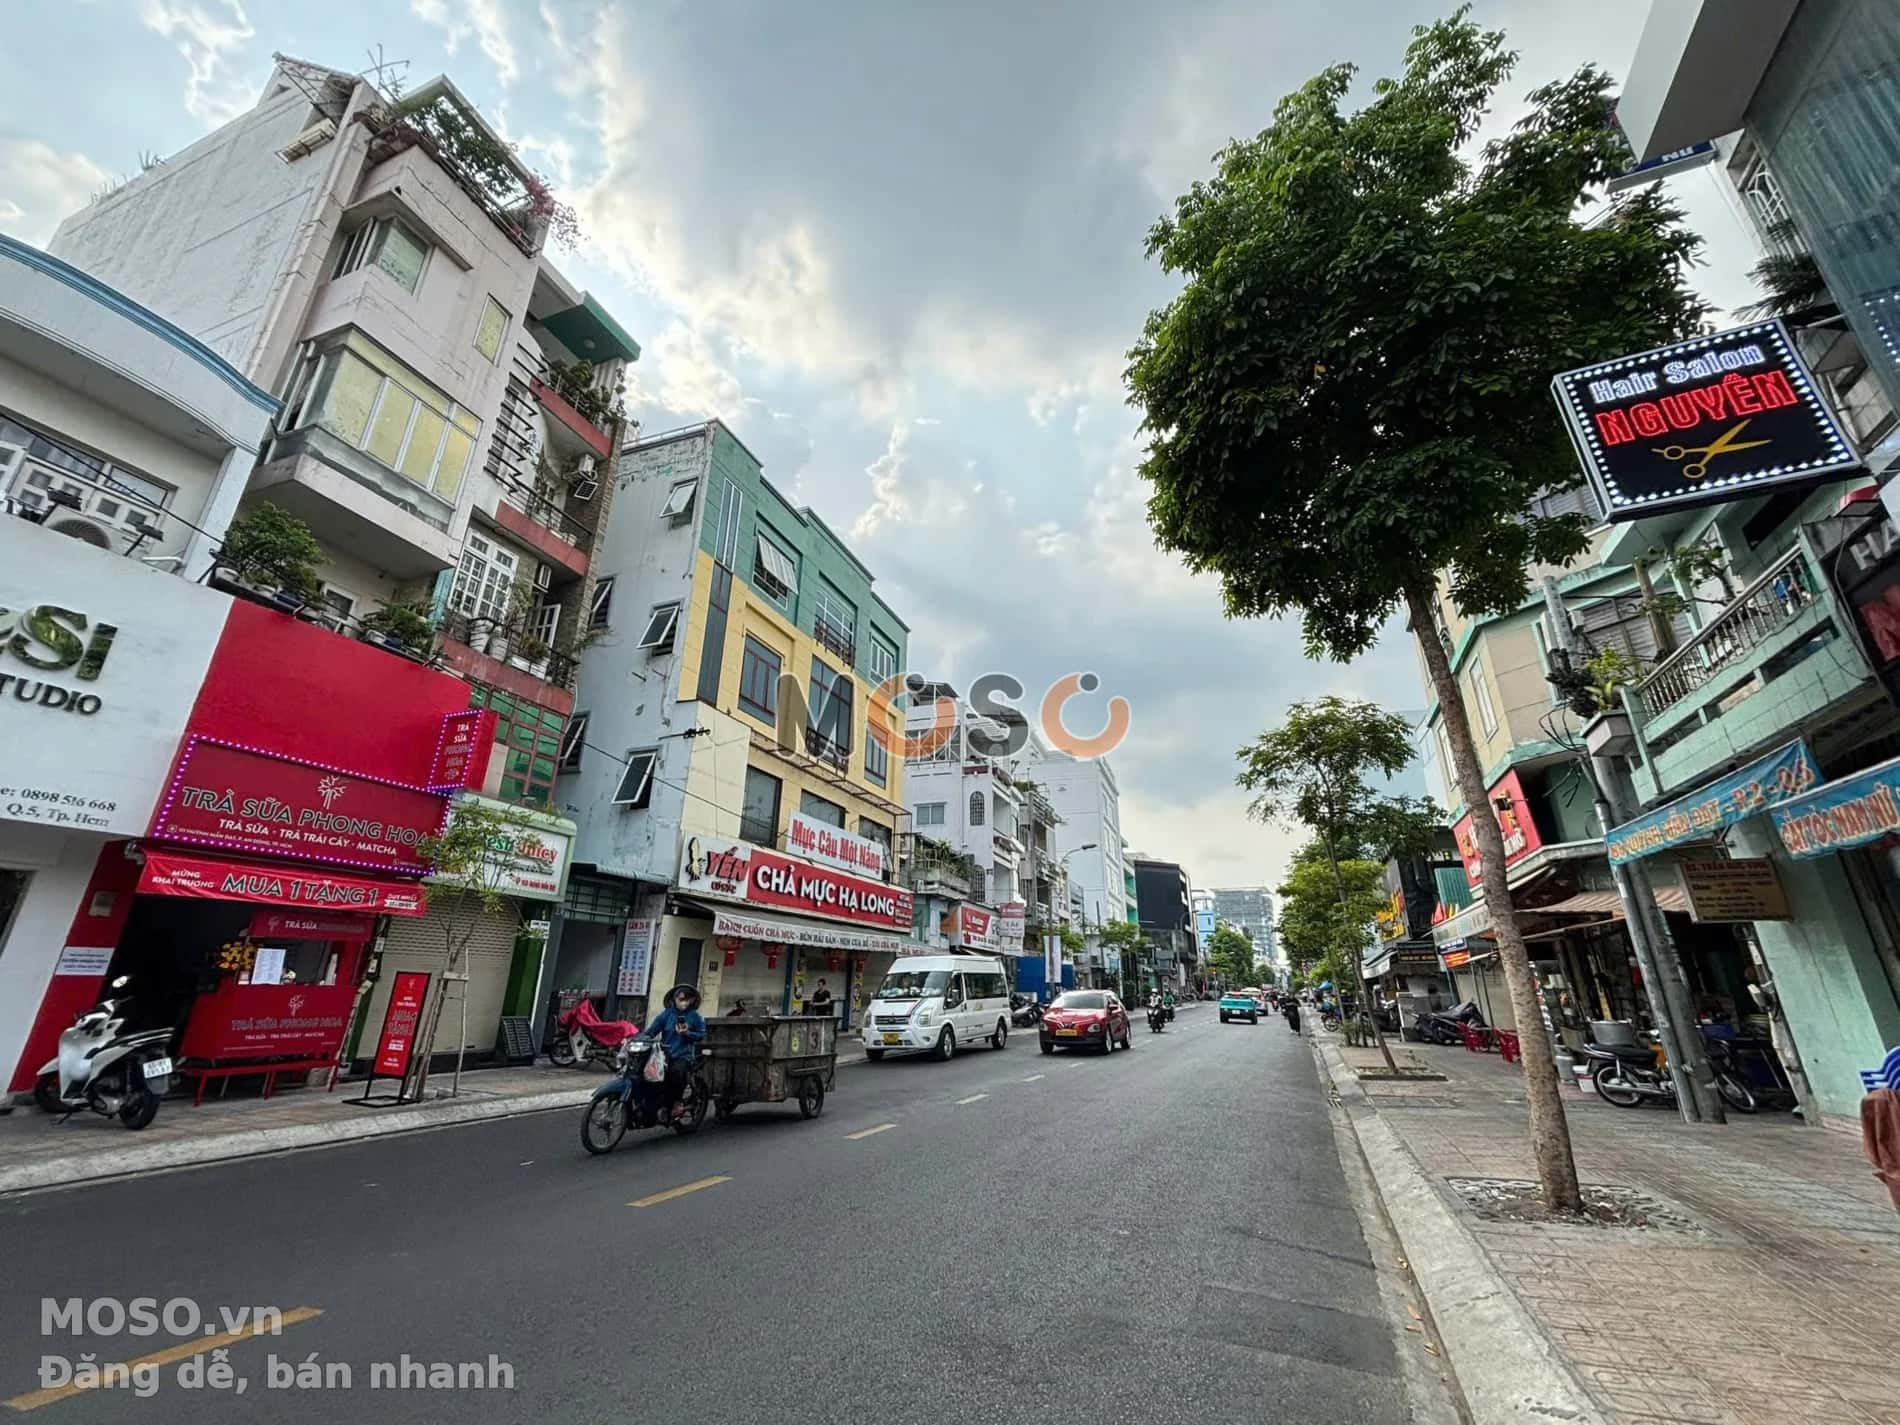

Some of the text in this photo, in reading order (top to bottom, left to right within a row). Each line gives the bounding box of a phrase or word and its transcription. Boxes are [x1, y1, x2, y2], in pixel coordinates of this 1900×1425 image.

[1589, 343, 1766, 403] Hair Salon
[0, 605, 118, 681] SI
[21, 788, 60, 803] 0898
[88, 800, 117, 812] 668
[181, 786, 430, 848] TRÀ SỮA PHONG HOA
[245, 822, 269, 835] SỮA
[303, 832, 326, 844] TRÁI
[356, 842, 397, 856] MATCHA
[790, 818, 881, 875] Mực Câu Một Nắng
[152, 876, 174, 885] KHAI
[705, 845, 749, 882] YẾN
[220, 872, 379, 907] MUA 1 TẶNG 1
[756, 864, 796, 894] CHẢ
[800, 878, 837, 908] MỰC
[838, 889, 859, 914] HẠ
[860, 891, 895, 915] LONG
